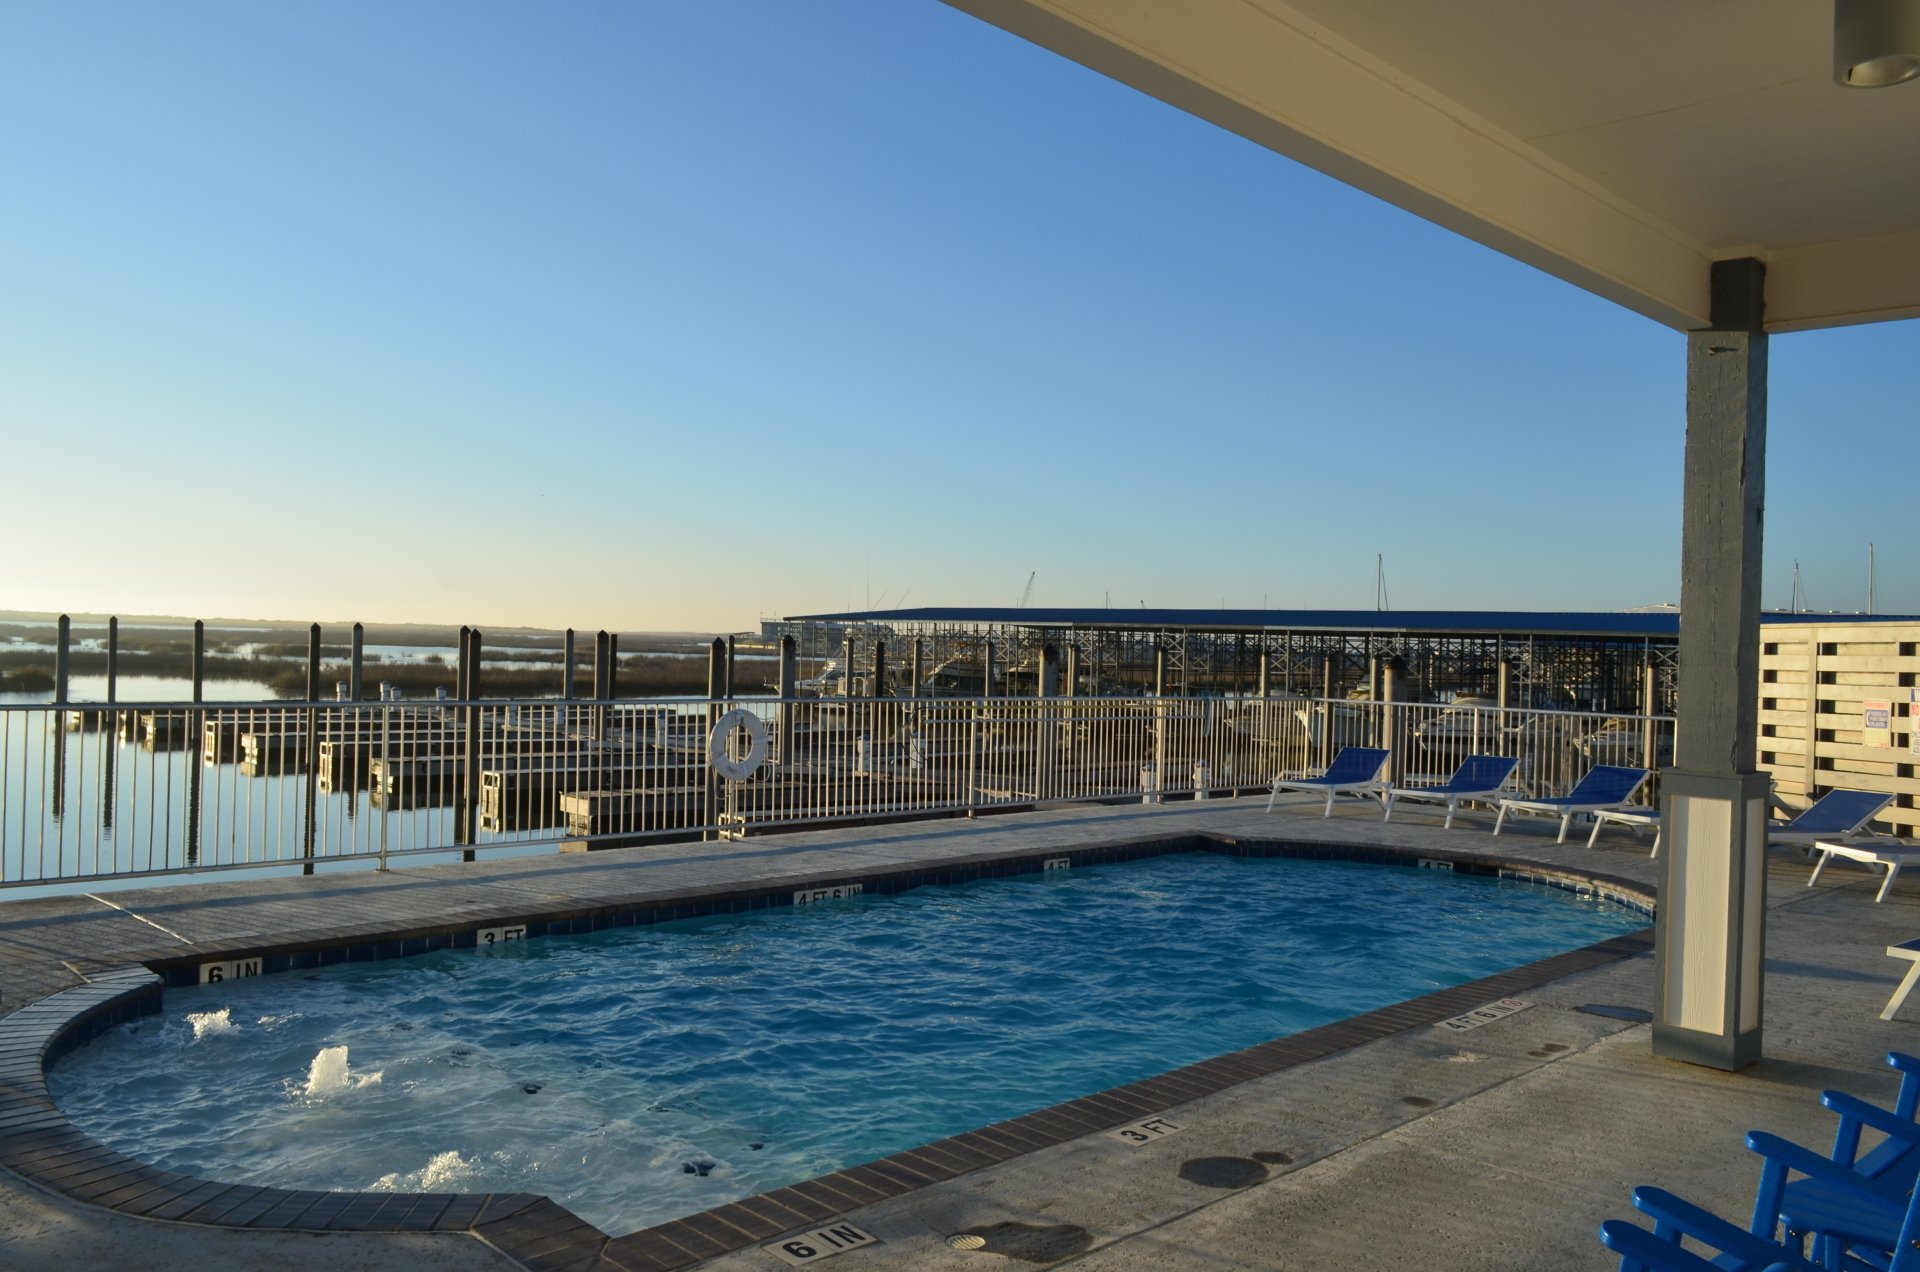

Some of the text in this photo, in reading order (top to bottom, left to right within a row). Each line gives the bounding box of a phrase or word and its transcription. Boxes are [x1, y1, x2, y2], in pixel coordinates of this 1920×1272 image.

[813, 890, 827, 902] FT
[848, 885, 860, 897] IN
[484, 928, 524, 945] 3 FT
[208, 961, 258, 984] 6 IN
[1445, 1021, 1468, 1029] 4
[1486, 1004, 1516, 1014] IN
[1120, 1118, 1179, 1141] 3 FT
[782, 1225, 866, 1258] 6 IN
